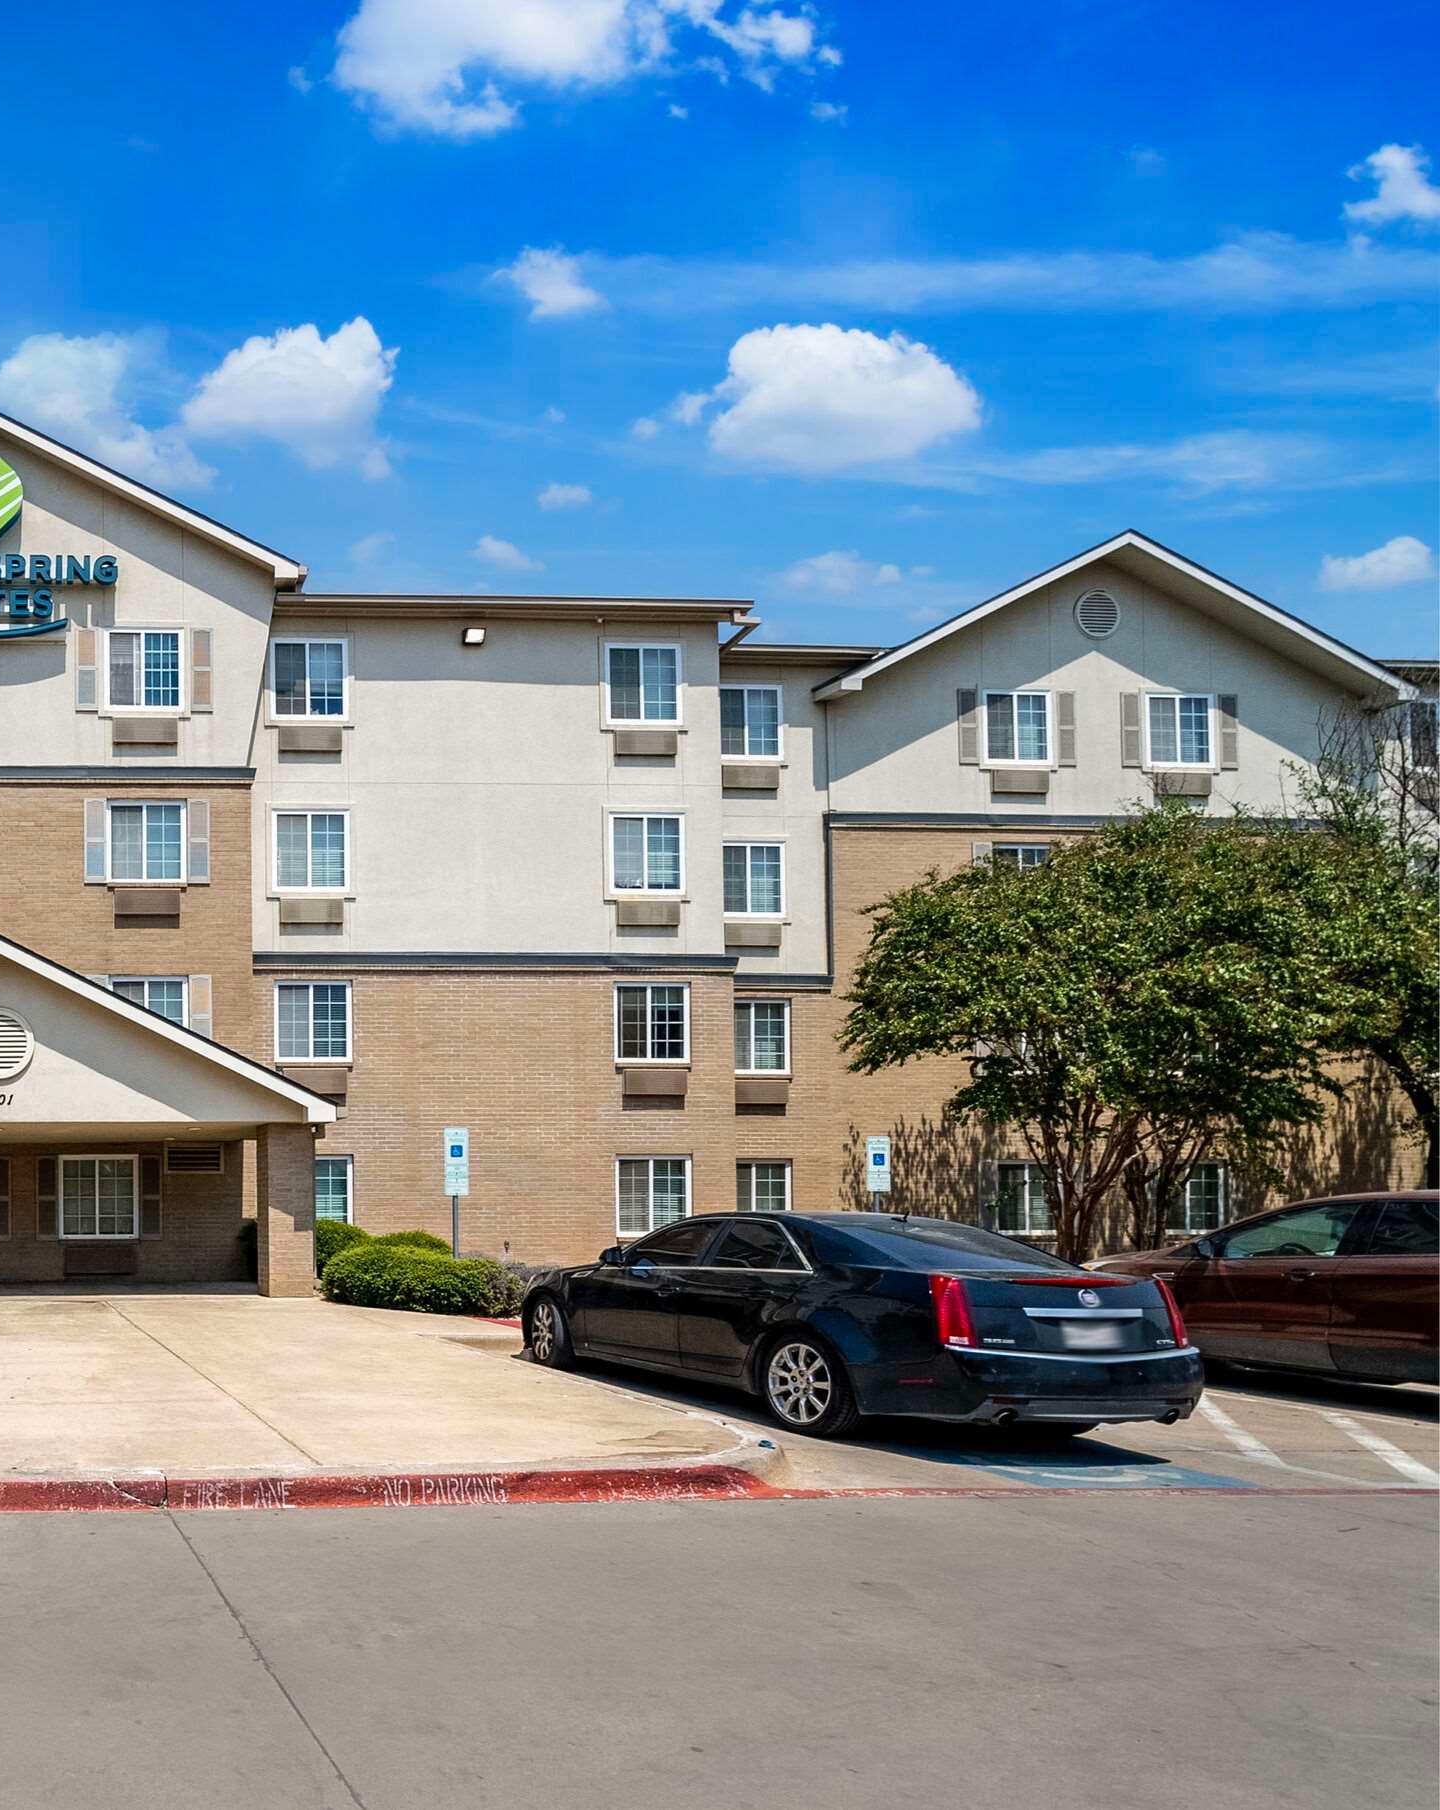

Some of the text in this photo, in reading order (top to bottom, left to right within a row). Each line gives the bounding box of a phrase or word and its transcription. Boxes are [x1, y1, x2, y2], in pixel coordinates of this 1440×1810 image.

[183, 1479, 295, 1509] FIRE LANE
[383, 1476, 508, 1506] NO PARKING
